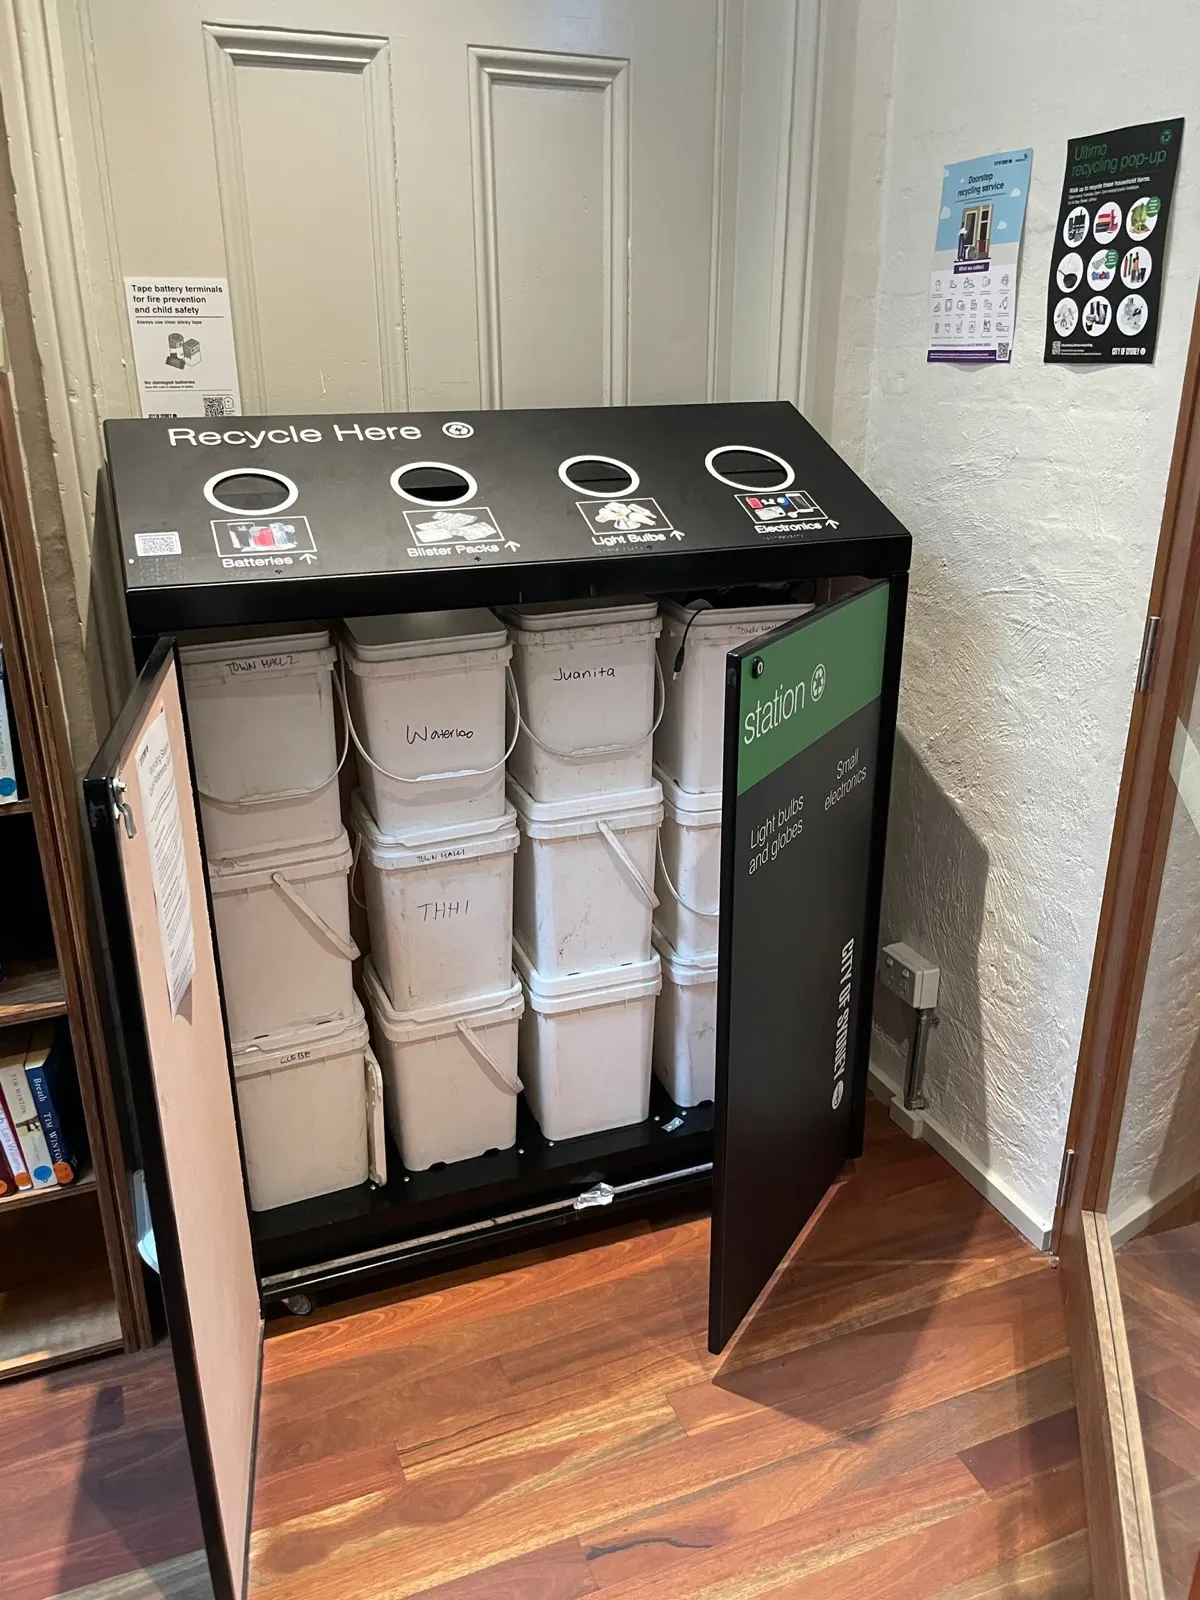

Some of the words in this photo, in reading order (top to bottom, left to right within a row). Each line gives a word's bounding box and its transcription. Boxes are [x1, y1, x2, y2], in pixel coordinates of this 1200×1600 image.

[1074, 144, 1108, 160] Ultimo
[1072, 157, 1118, 178] recycling
[1120, 150, 1166, 172] pop-up
[968, 173, 993, 184] Doorstep
[1114, 178, 1137, 186] household
[958, 186, 980, 197] recycling
[982, 182, 1004, 192] service
[132, 285, 152, 294] Tape
[154, 285, 183, 294] battery
[185, 285, 223, 293] terminals
[163, 296, 206, 304] prevention
[134, 306, 150, 314] and
[152, 306, 172, 314] child
[174, 306, 199, 315] safety
[167, 424, 322, 449] Recycle
[332, 423, 422, 442] Here
[754, 522, 822, 534] Electronics
[592, 534, 628, 546] Light
[630, 533, 666, 543] Bulbs
[406, 545, 453, 557] Blister
[455, 543, 500, 555] Packs
[222, 554, 293, 569] Batteries
[225, 661, 256, 675] TOWN
[553, 666, 616, 682] Juanita
[744, 680, 805, 745] station
[406, 724, 474, 744] Waterloo
[836, 748, 860, 780] Small
[824, 765, 867, 811] electronics
[750, 814, 775, 850] Light
[777, 795, 804, 826] bulbs
[748, 841, 769, 875] and
[771, 819, 803, 862] globes
[840, 938, 854, 984] CITY
[838, 982, 851, 1009] OF
[833, 1007, 850, 1080] SYDNEY
[11, 1074, 19, 1088] TIM
[16, 1089, 26, 1114] WINTON
[33, 1077, 46, 1102] Breath
[43, 1112, 53, 1128] TIM
[50, 1131, 64, 1164] WINTON
